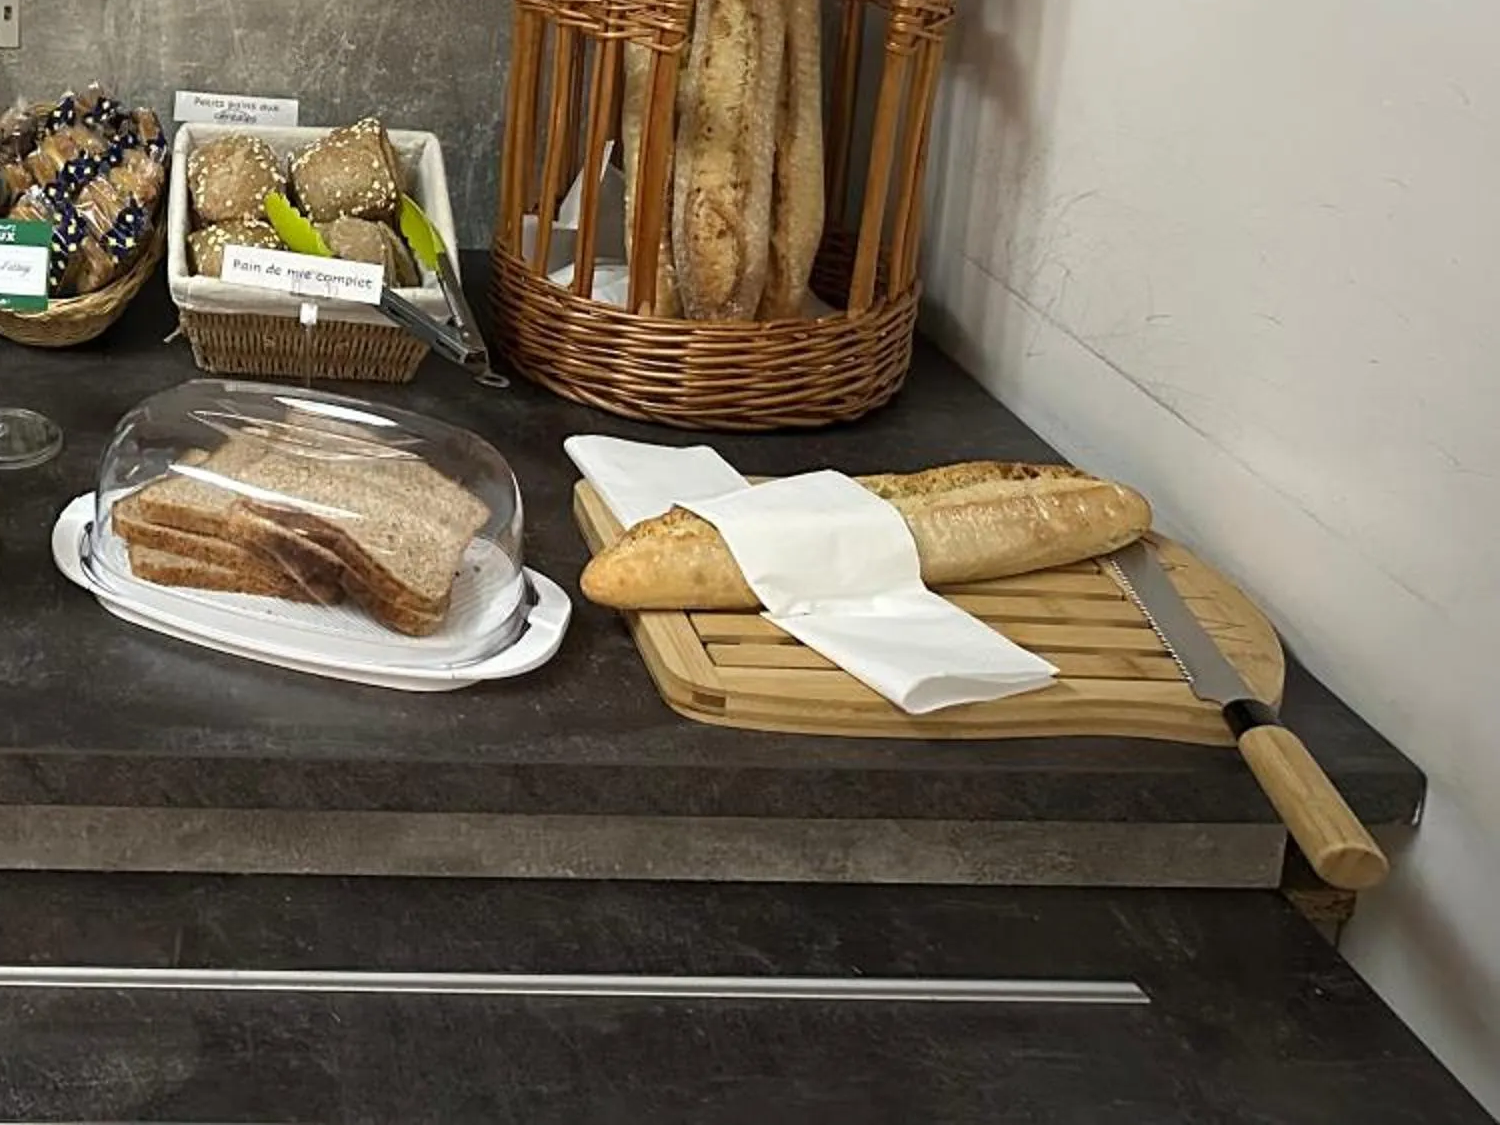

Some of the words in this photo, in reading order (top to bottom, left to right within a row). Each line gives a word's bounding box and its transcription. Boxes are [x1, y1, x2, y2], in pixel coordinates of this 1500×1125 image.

[233, 258, 261, 272] Pain
[265, 263, 282, 276] de
[287, 267, 312, 280] mie
[315, 270, 372, 290] complet
